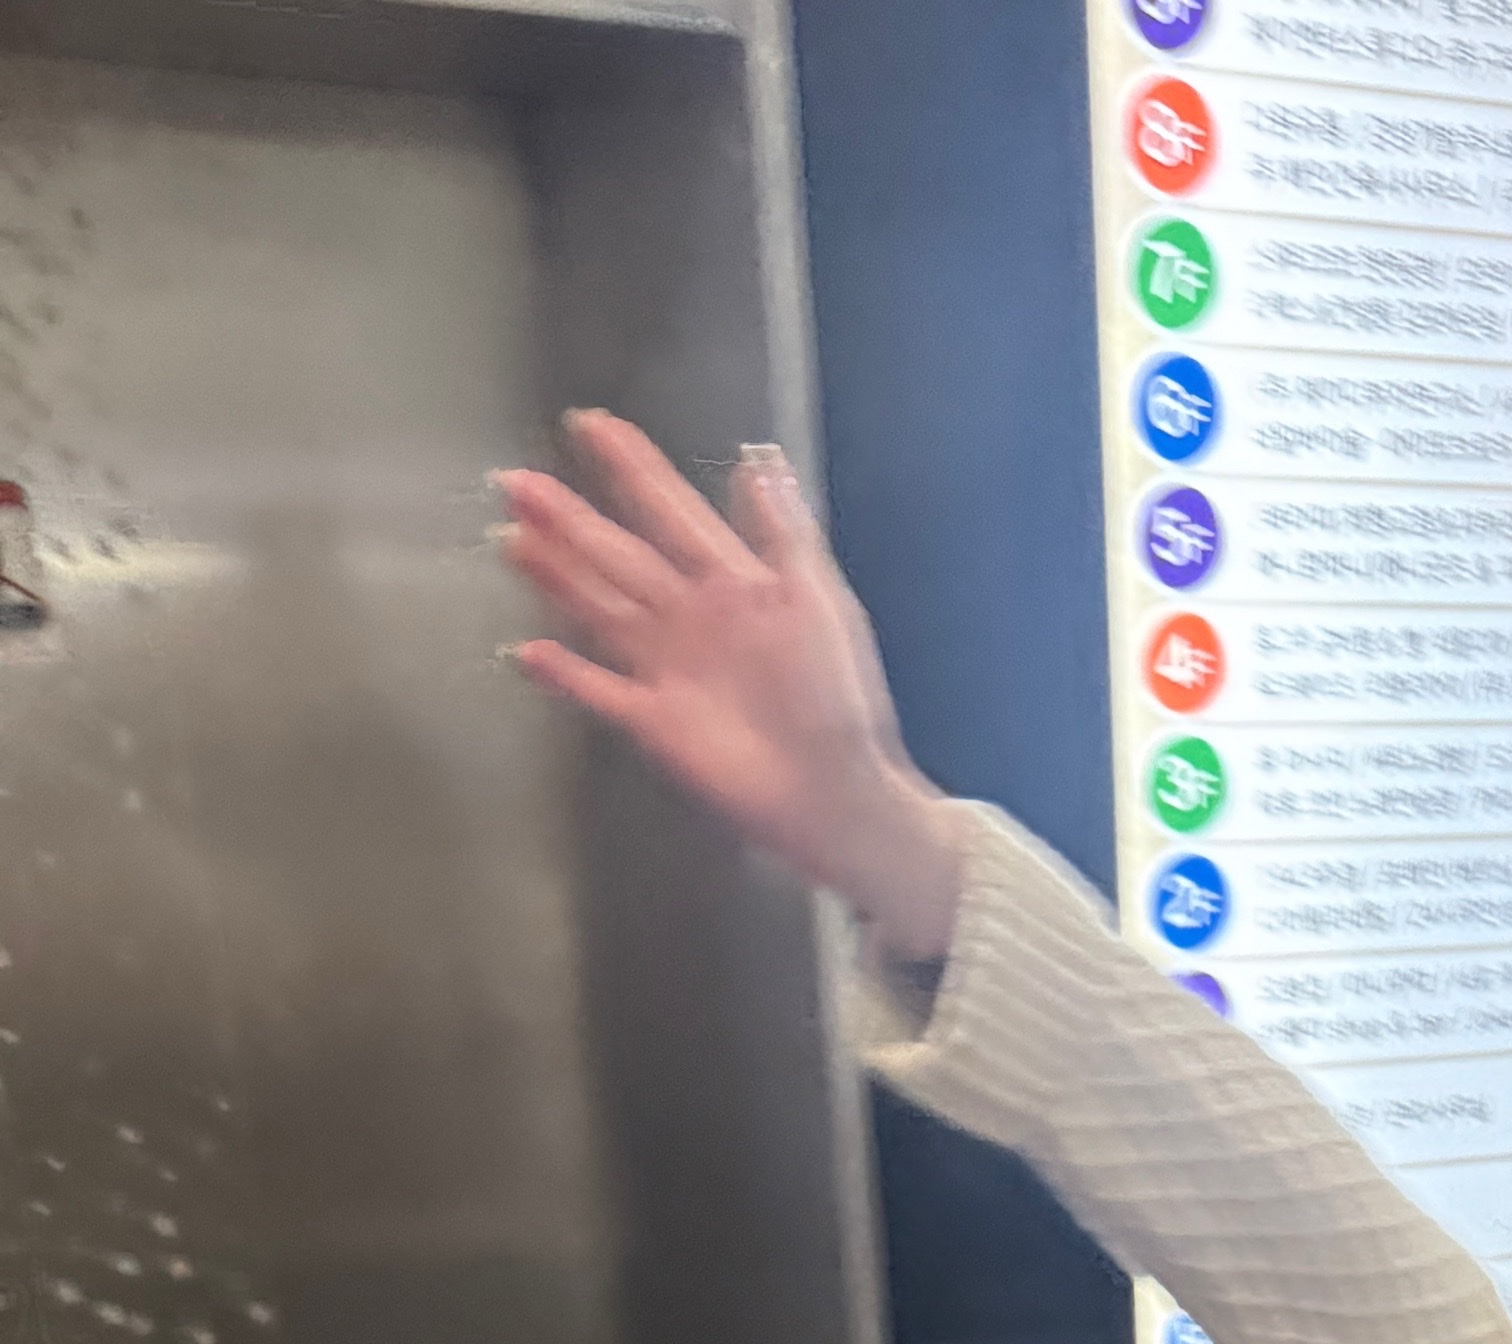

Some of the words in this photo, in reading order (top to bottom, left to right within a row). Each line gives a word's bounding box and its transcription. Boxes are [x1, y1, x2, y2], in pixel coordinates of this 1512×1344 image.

[1138, 99, 1208, 167] 8F
[1141, 239, 1210, 304] 7F
[1146, 374, 1213, 439] 6F
[1148, 505, 1215, 567] 5F
[1152, 632, 1216, 690] 4F
[1156, 752, 1220, 813] 3F
[1161, 872, 1222, 930] 2F
